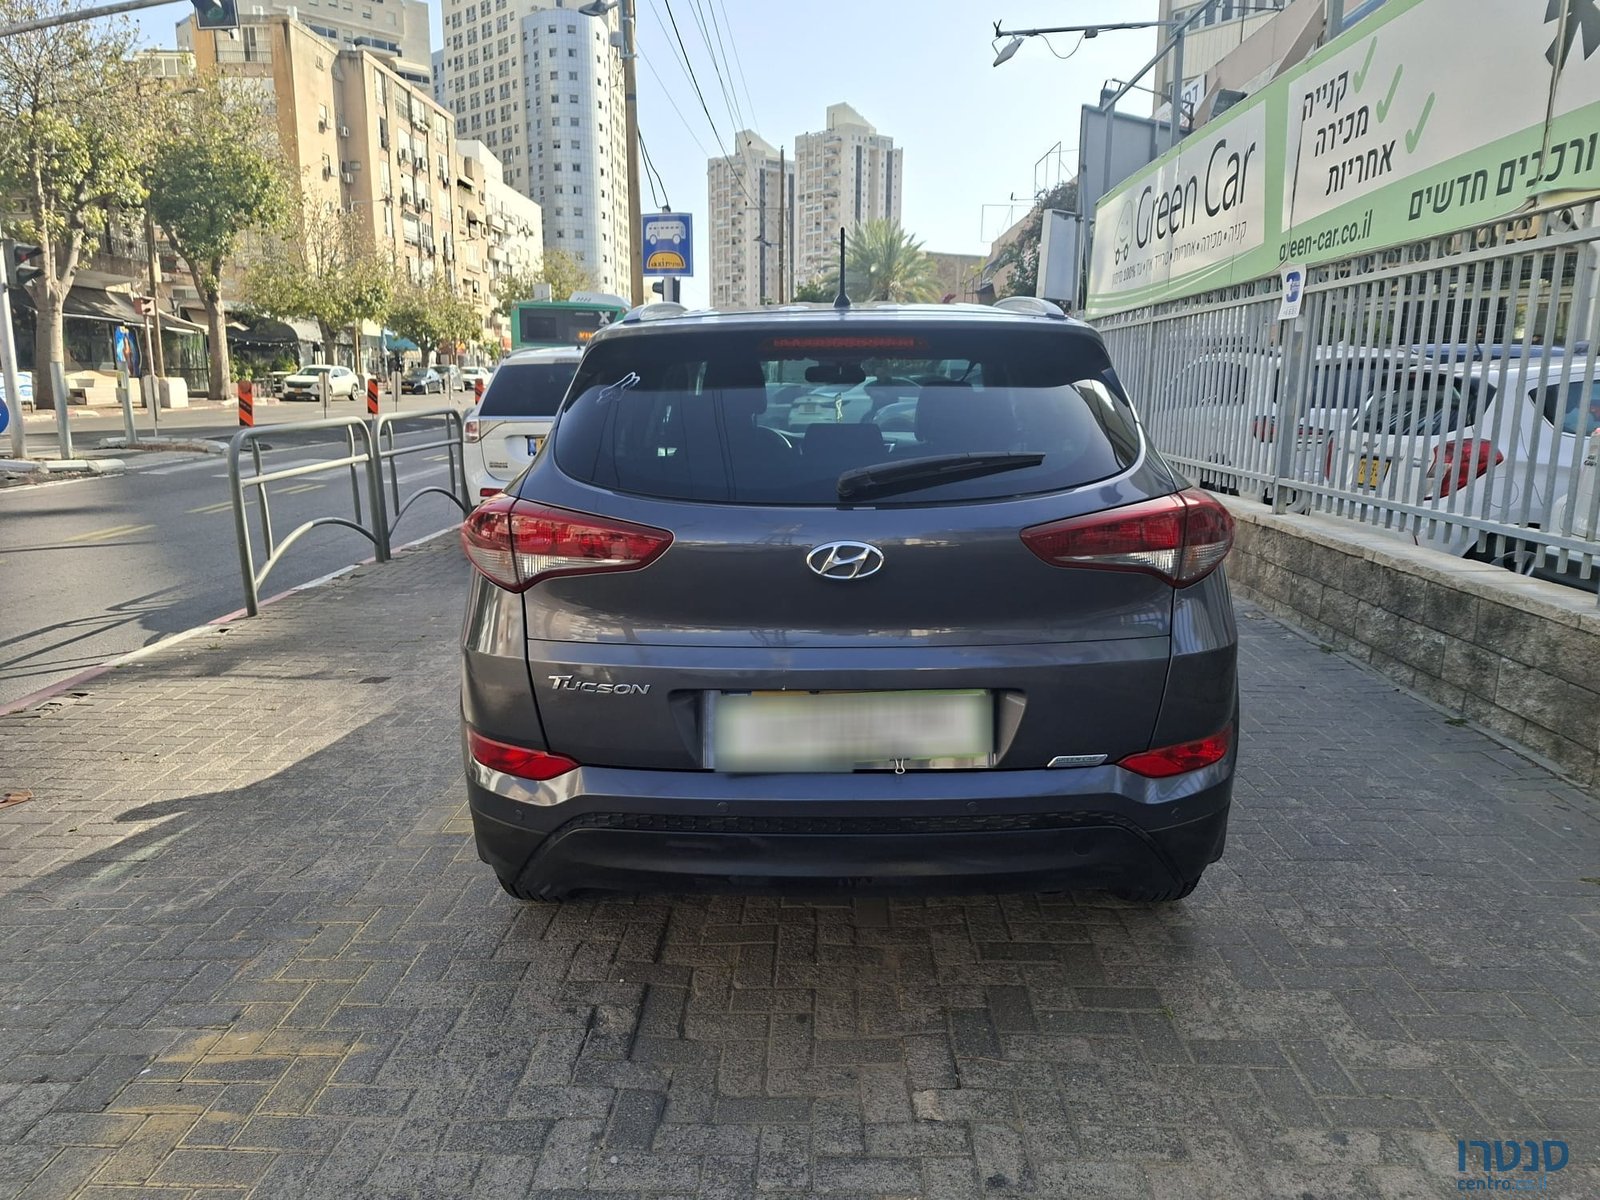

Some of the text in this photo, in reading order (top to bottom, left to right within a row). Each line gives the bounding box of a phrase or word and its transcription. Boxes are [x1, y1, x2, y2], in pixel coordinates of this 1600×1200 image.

[1302, 70, 1349, 122] קנייה
[1314, 105, 1369, 157] מכירה
[1136, 138, 1256, 249] Green Car
[1325, 139, 1396, 196] אחריות
[1408, 168, 1488, 221] חדשים
